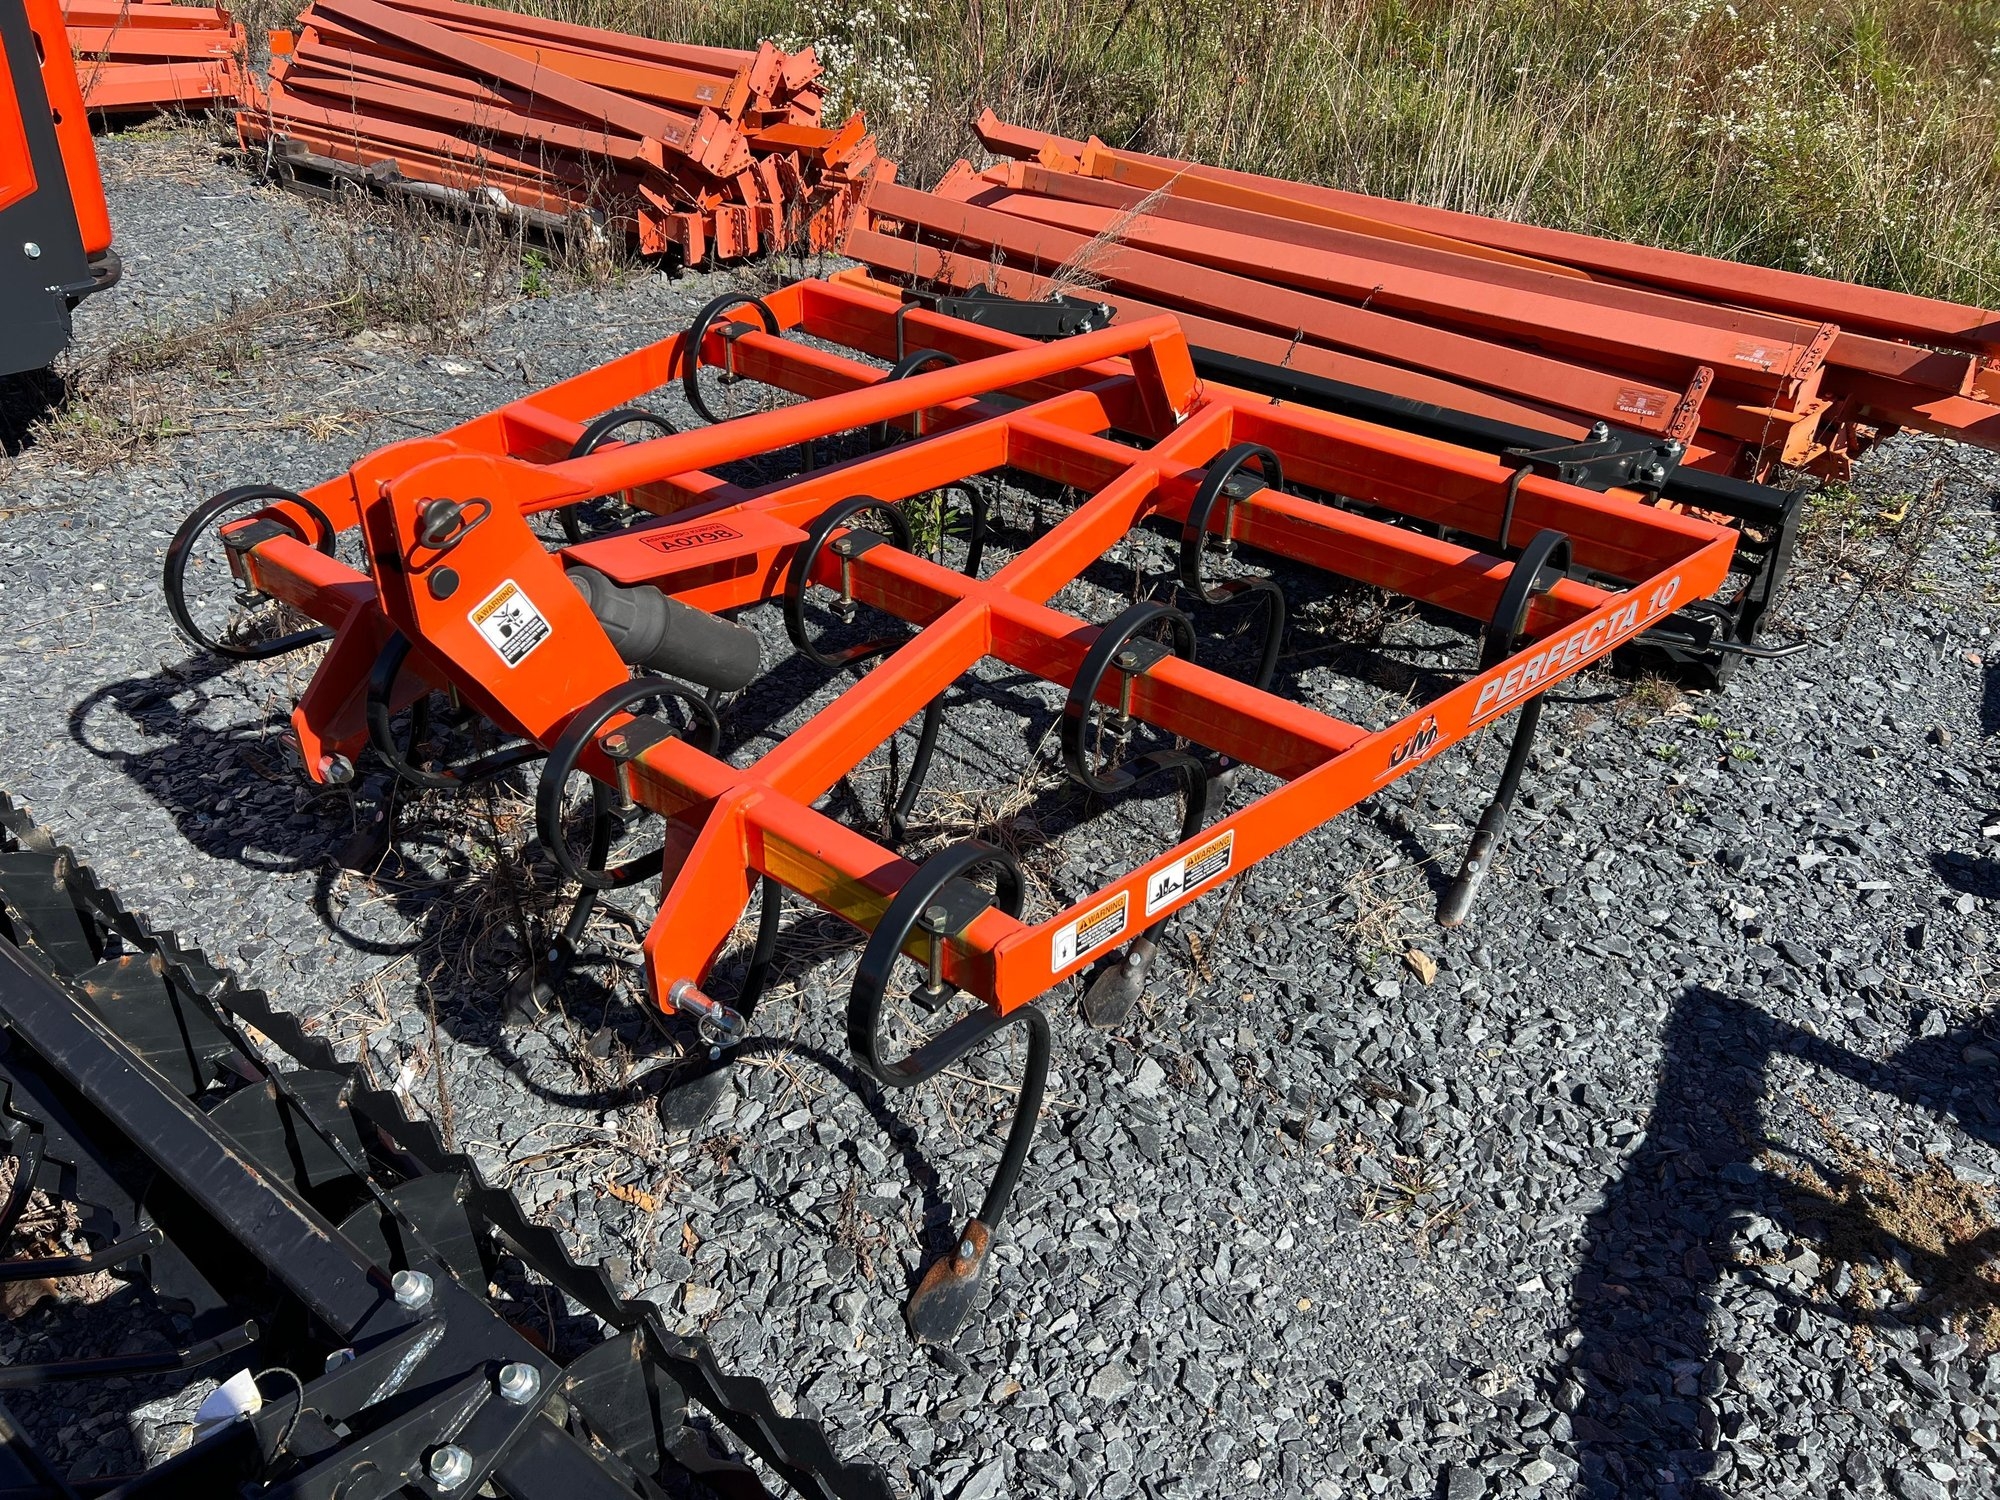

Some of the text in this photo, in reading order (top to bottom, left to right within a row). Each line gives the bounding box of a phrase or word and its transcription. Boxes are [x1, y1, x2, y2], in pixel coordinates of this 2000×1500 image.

[661, 529, 733, 550] A0798
[481, 586, 515, 617] WARNING
[1472, 576, 1681, 716] PERFECTA 10
[1193, 836, 1230, 861] WARNING
[1088, 897, 1124, 925] WARNING
